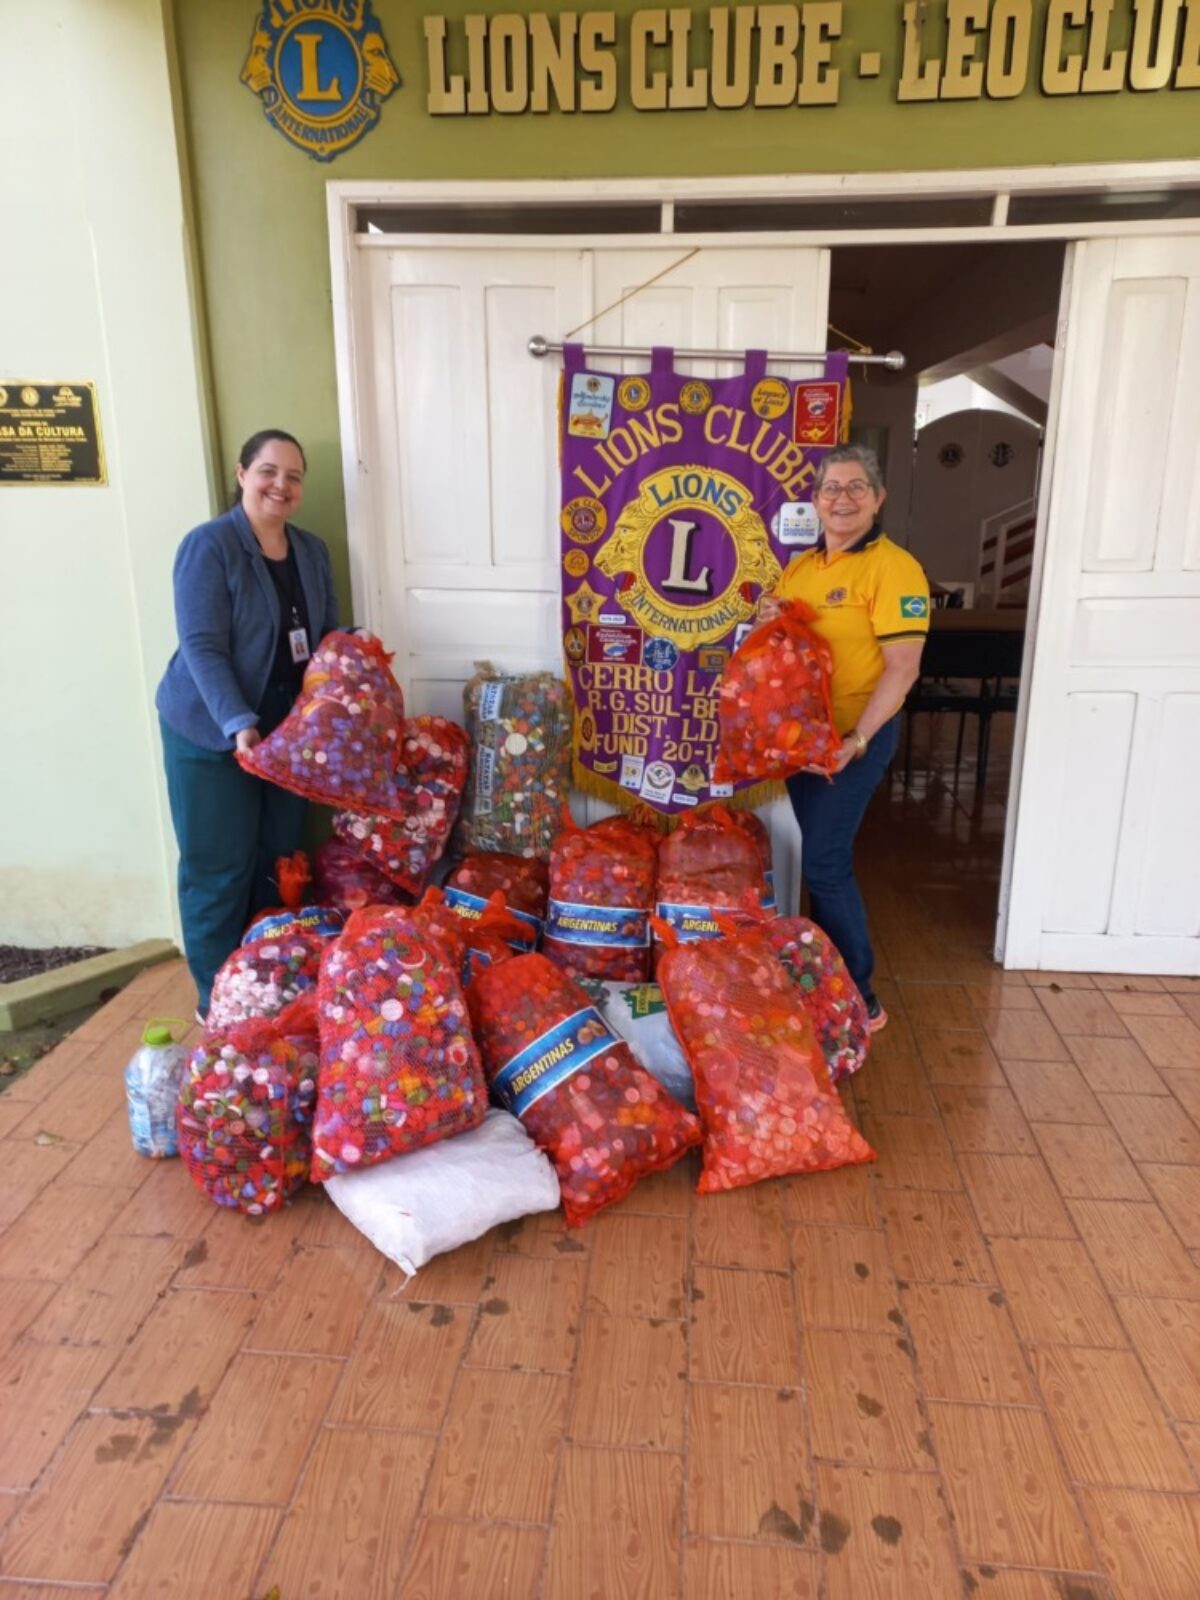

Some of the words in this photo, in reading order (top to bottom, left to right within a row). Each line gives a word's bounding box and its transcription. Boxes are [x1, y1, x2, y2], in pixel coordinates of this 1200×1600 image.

[294, 34, 342, 100] L
[424, 12, 617, 115] LIONS
[630, 1, 842, 110] CLUBE
[897, 0, 1033, 101] LEO
[275, 107, 368, 143] INTERNATIONAL
[36, 427, 85, 437] CULTURA
[573, 402, 684, 498] LIONS
[703, 403, 817, 500] CLUBE
[647, 472, 744, 517] LIONS
[660, 518, 710, 593] L
[630, 592, 739, 633] INTERNATIONAL
[578, 664, 674, 694] CERRO
[593, 732, 649, 758] FUND
[612, 711, 671, 740] DIST.
[556, 915, 619, 933] ARGENTINAS
[511, 1037, 576, 1096] ARGENTINAS
